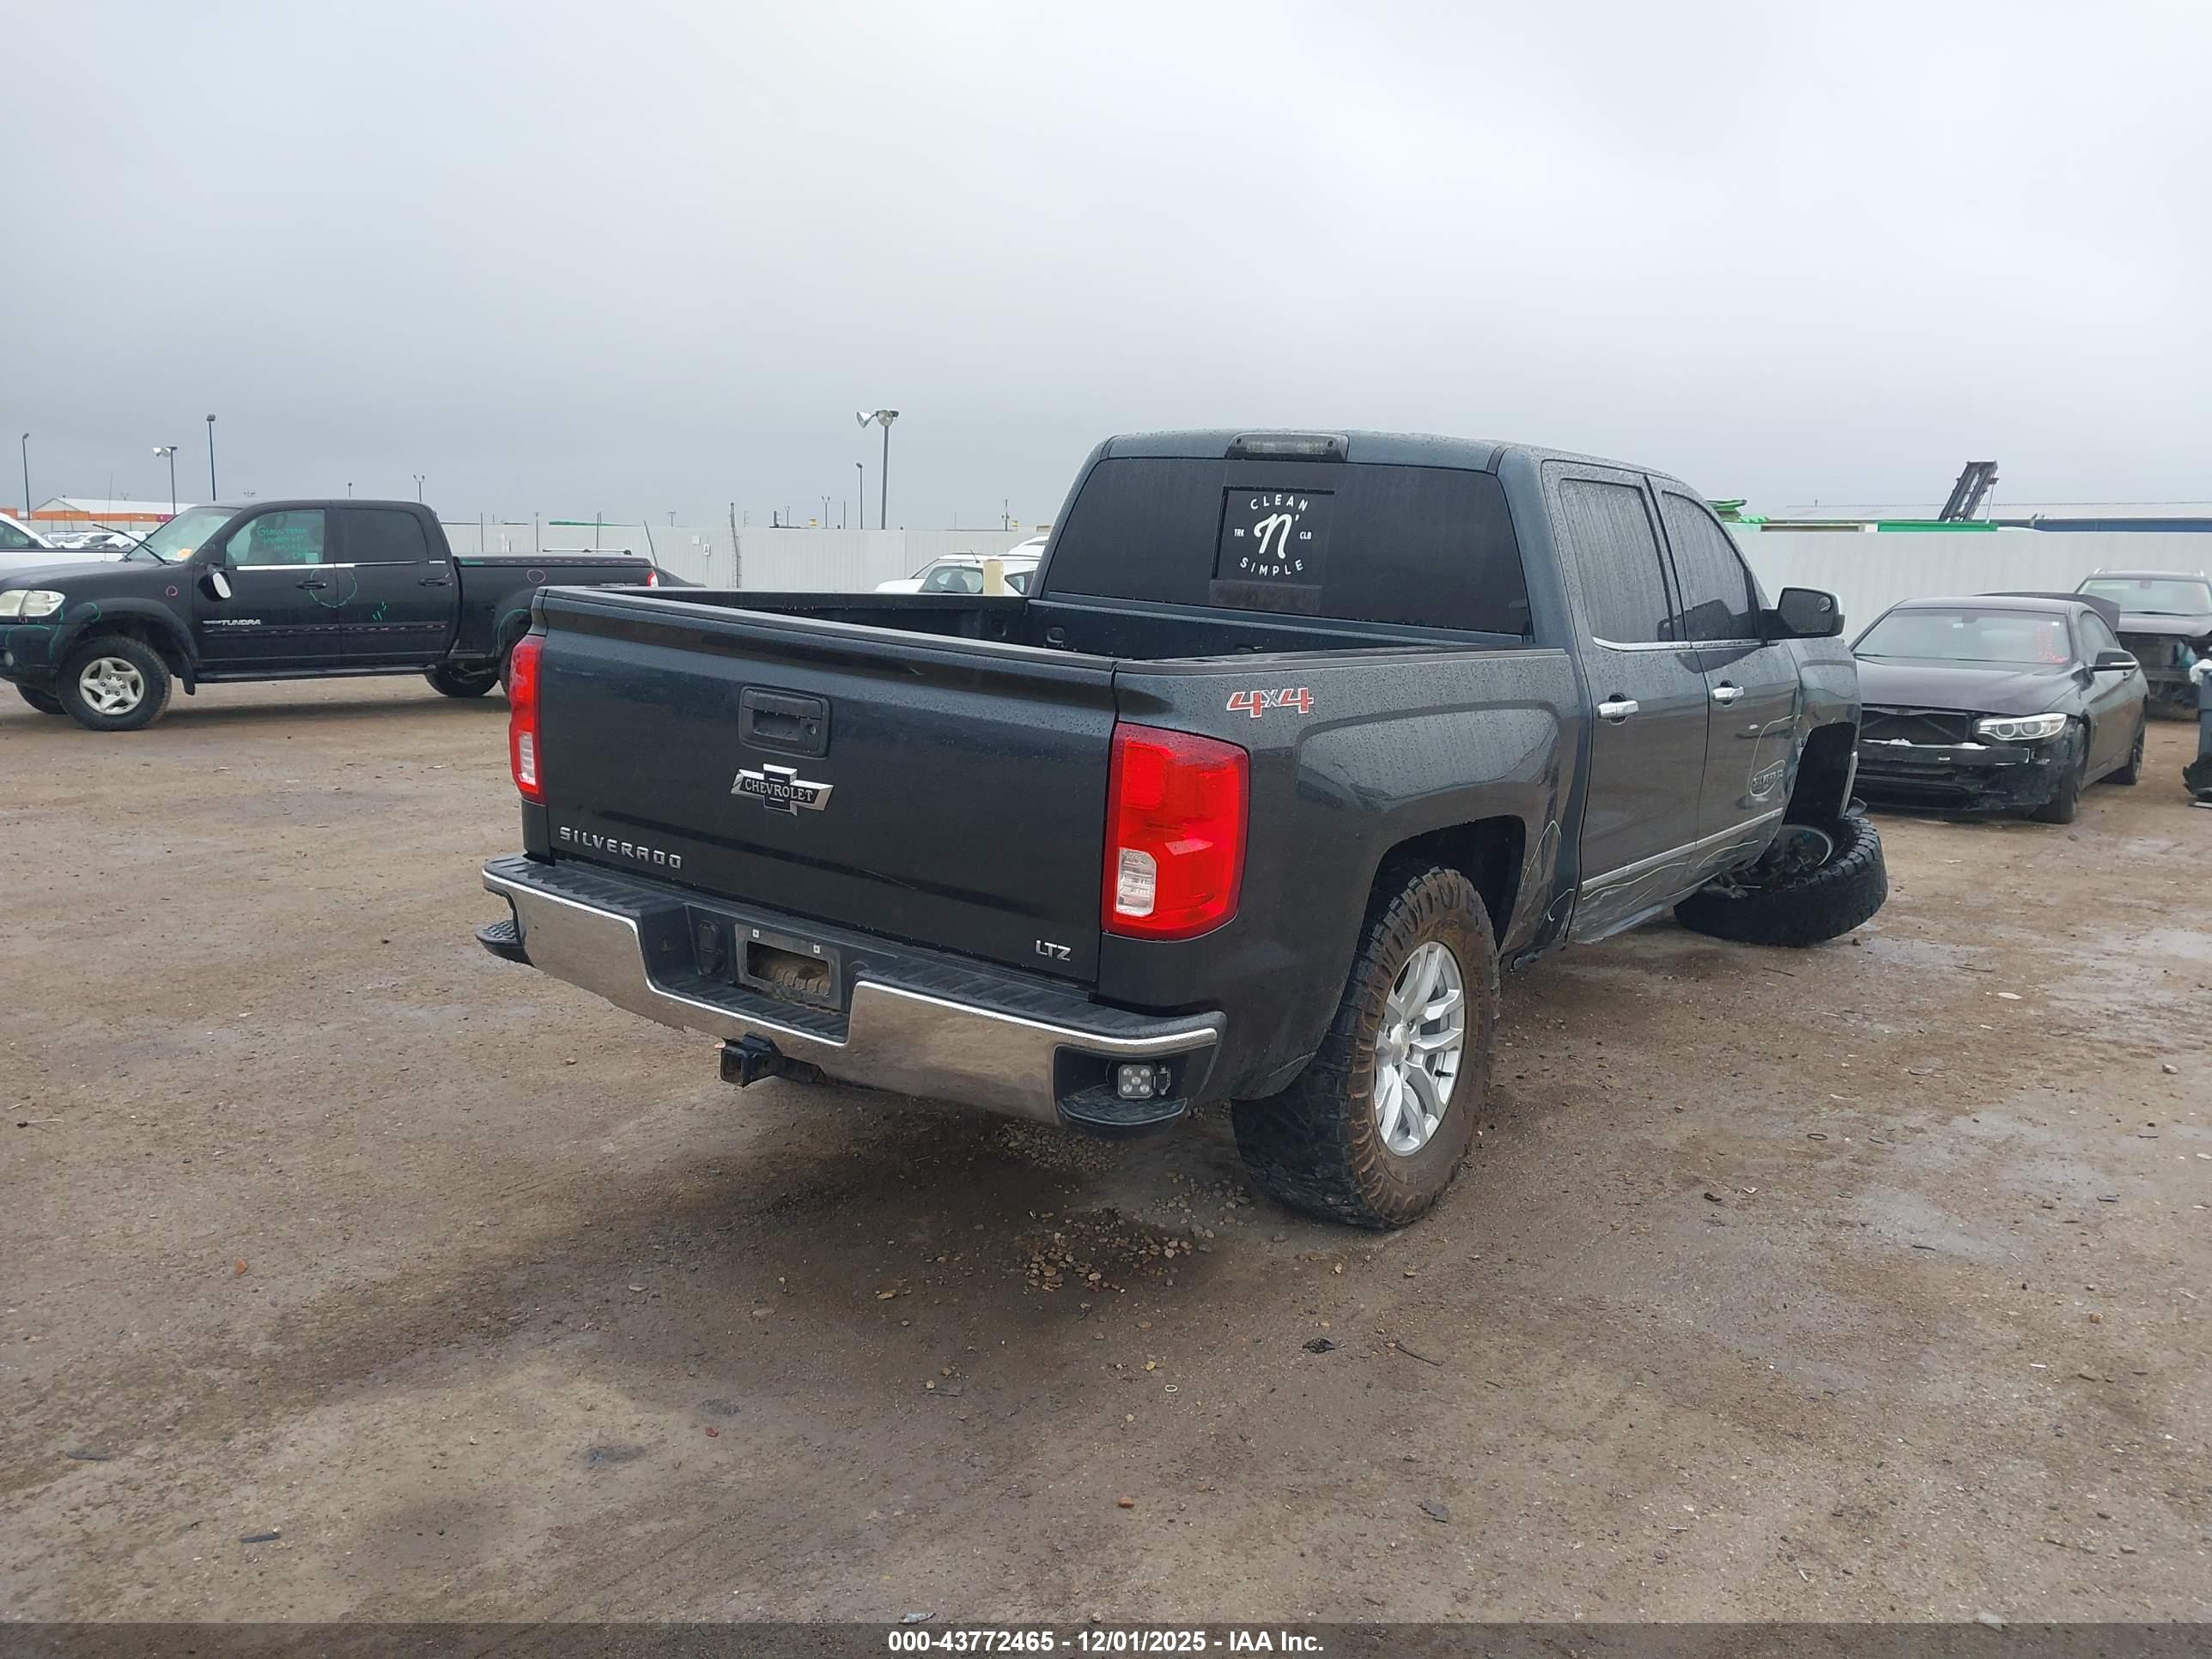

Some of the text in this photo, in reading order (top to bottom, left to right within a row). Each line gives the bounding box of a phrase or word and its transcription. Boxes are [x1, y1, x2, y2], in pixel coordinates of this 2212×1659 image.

[1250, 494, 1309, 512] CLEAN
[1239, 556, 1304, 577] SIMPLE
[744, 778, 813, 802] CHEVROLET
[559, 826, 682, 869] SILVERADO
[1036, 939, 1072, 962] LTZ
